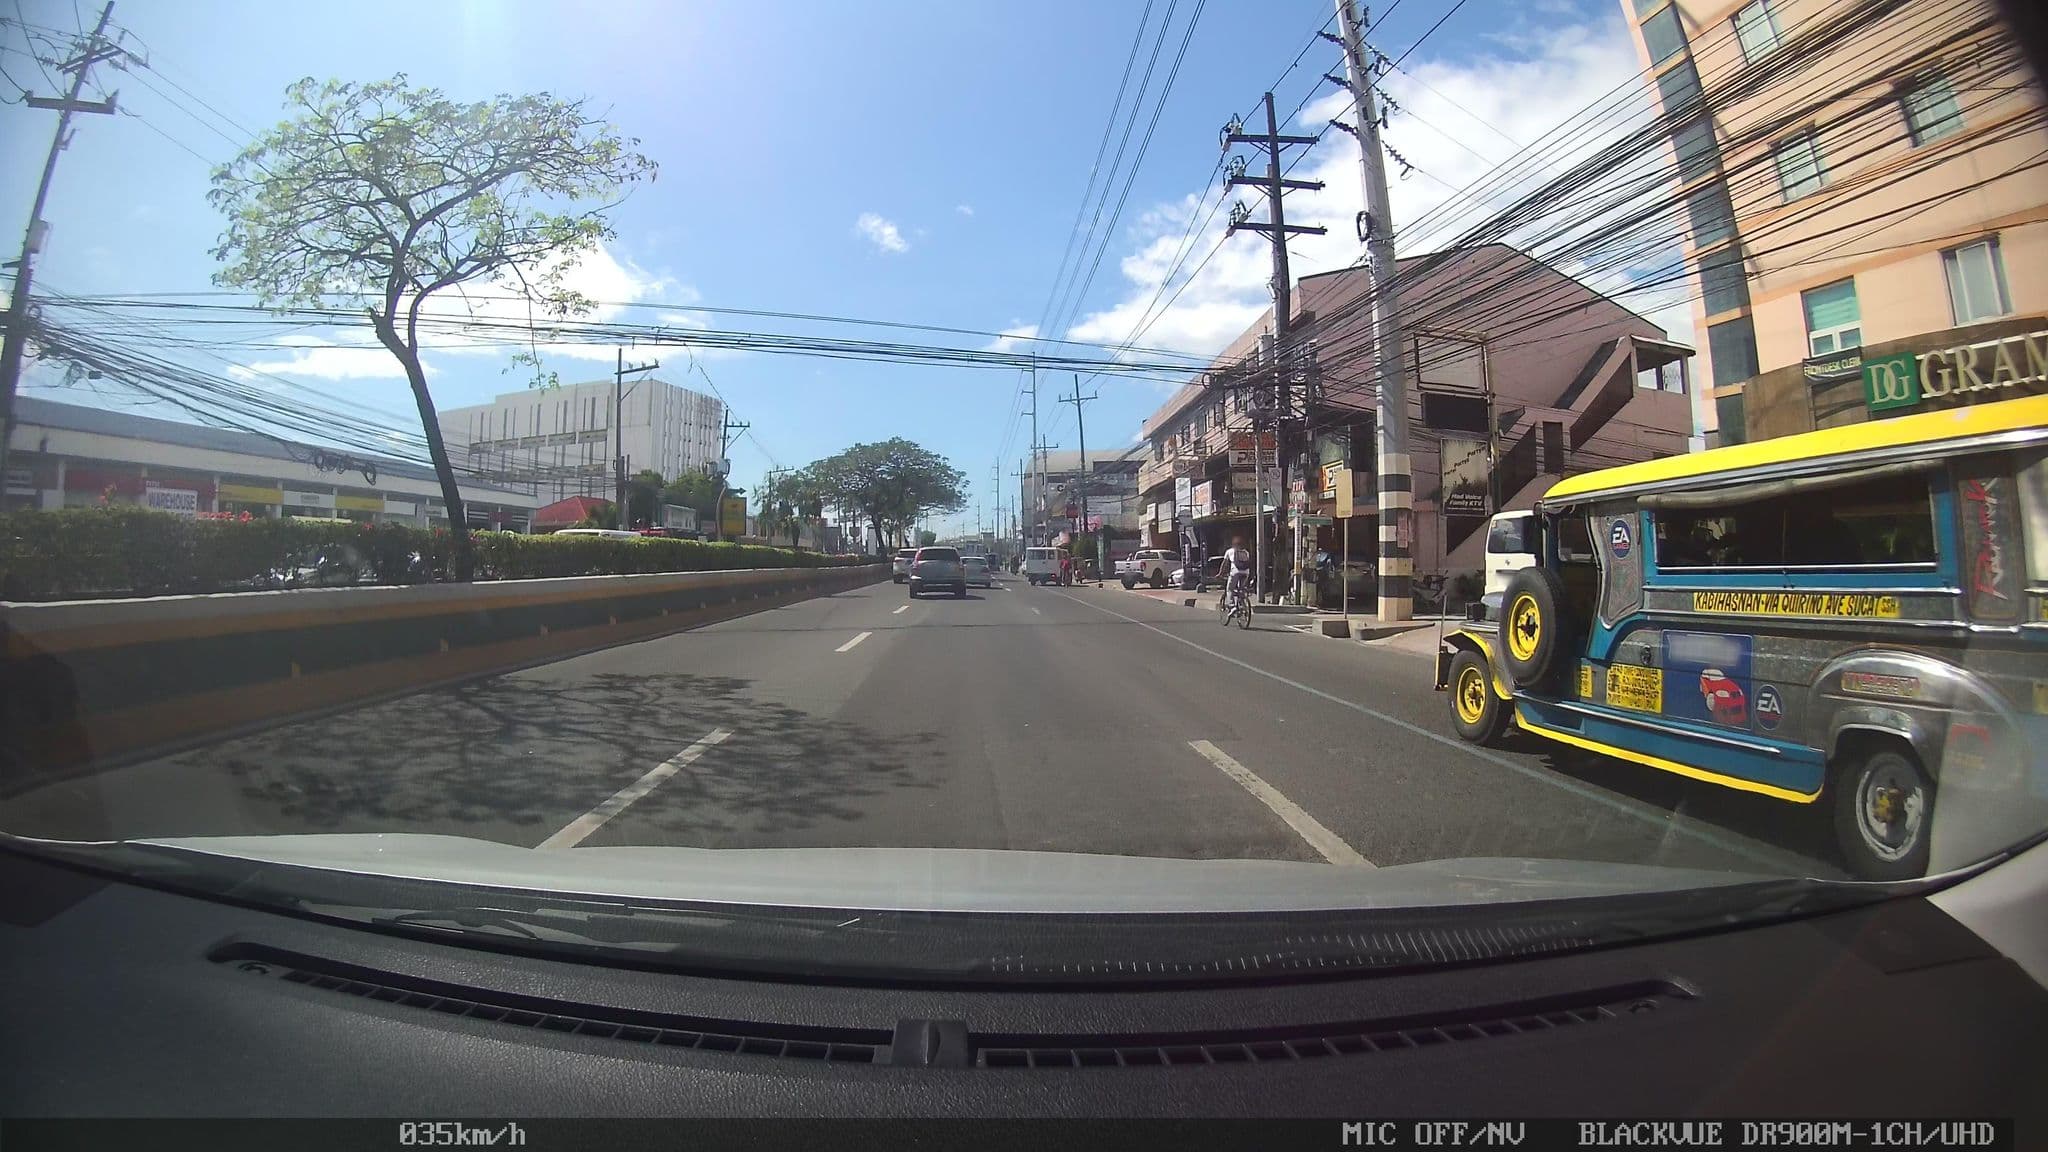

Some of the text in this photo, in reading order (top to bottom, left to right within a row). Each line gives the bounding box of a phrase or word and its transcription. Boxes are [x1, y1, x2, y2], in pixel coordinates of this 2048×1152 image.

[1867, 359, 1911, 404] DG
[148, 493, 196, 511] WAREHOUSE
[1612, 526, 1630, 543] EA
[1781, 593, 1823, 615] QUIRINO
[1825, 594, 1845, 616] AVE
[1846, 594, 1881, 617] SUCAT
[1756, 692, 1782, 715] EA
